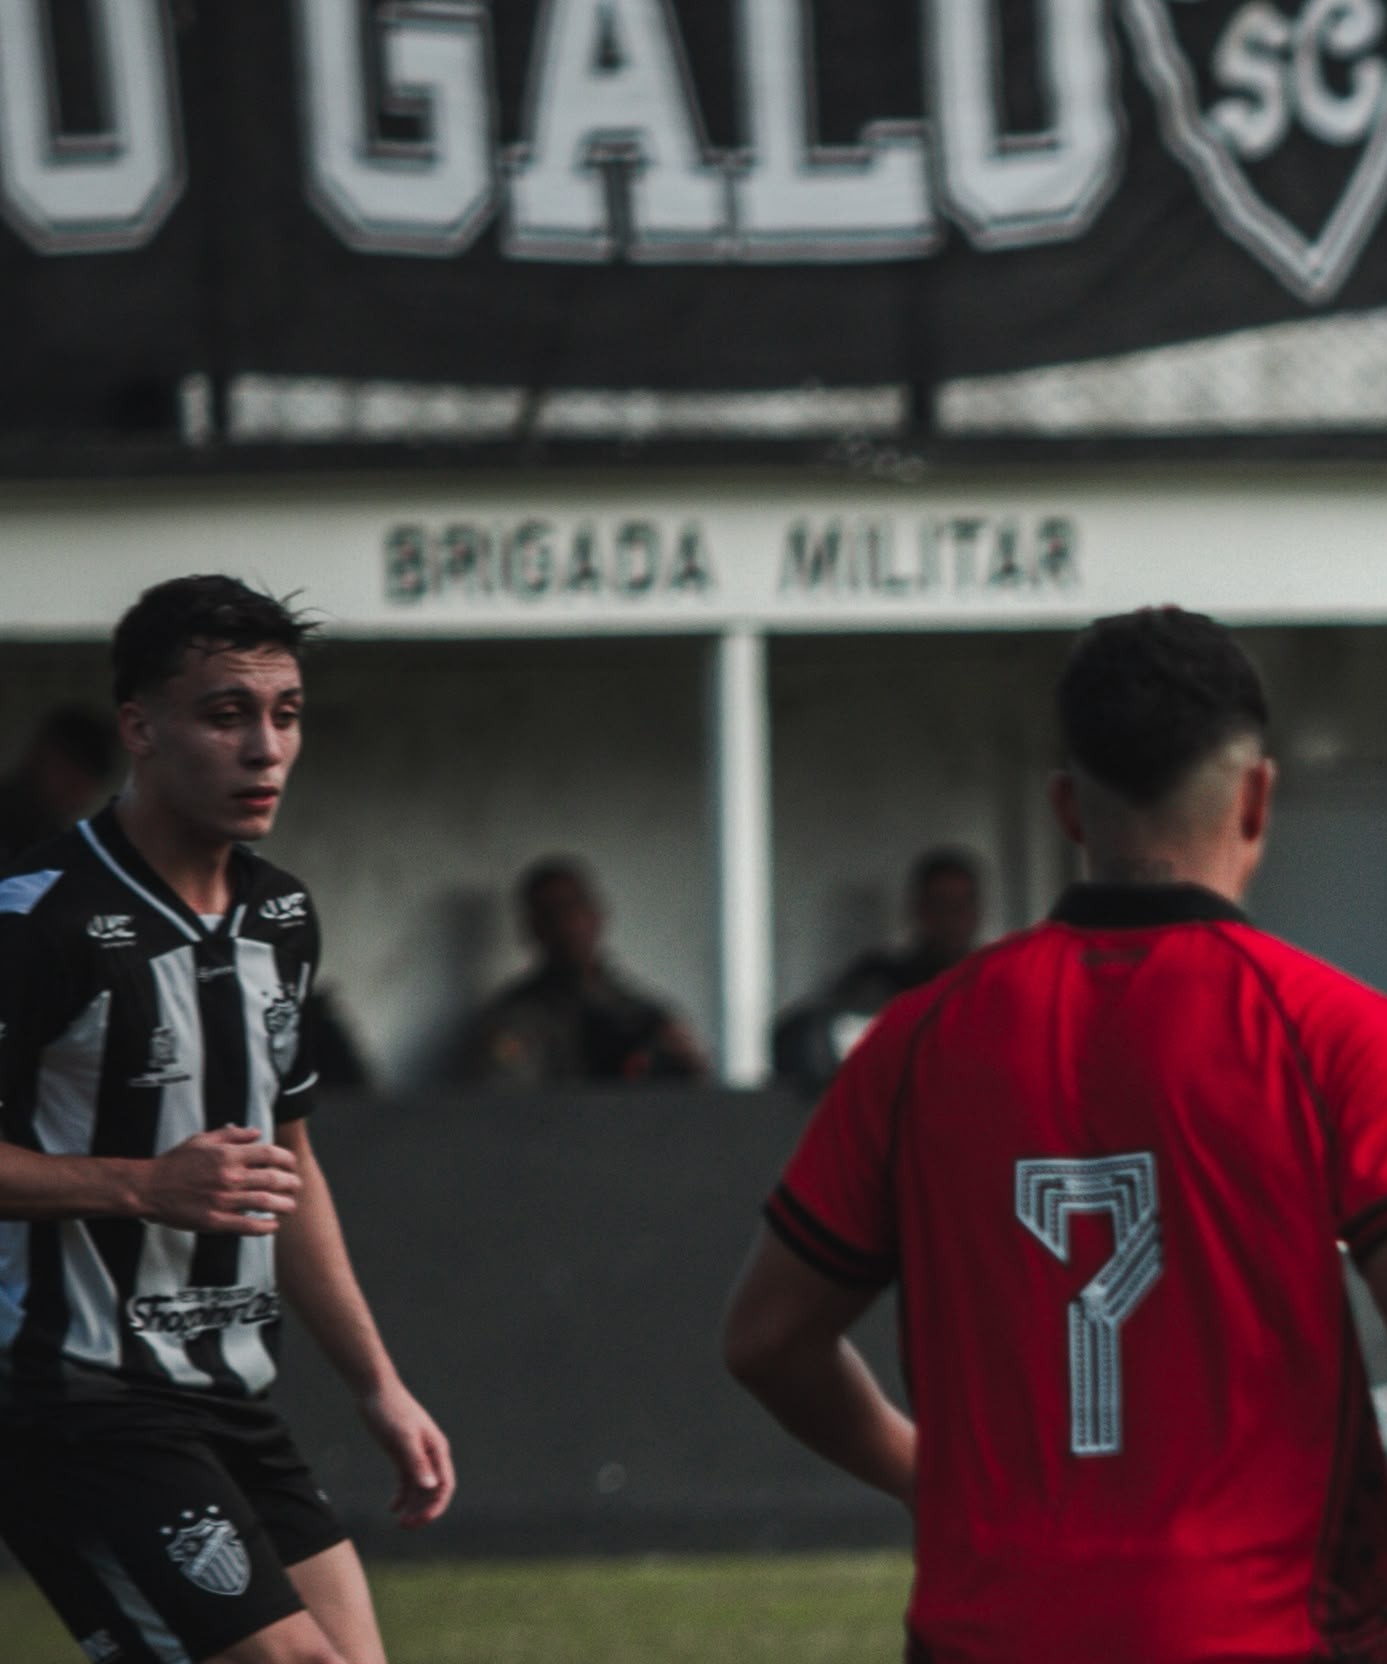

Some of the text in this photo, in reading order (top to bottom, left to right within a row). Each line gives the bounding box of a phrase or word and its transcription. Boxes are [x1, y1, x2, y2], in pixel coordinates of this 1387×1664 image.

[383, 514, 1084, 606] BRIGADA MILITAR
[1014, 1151, 1164, 1458] 7
